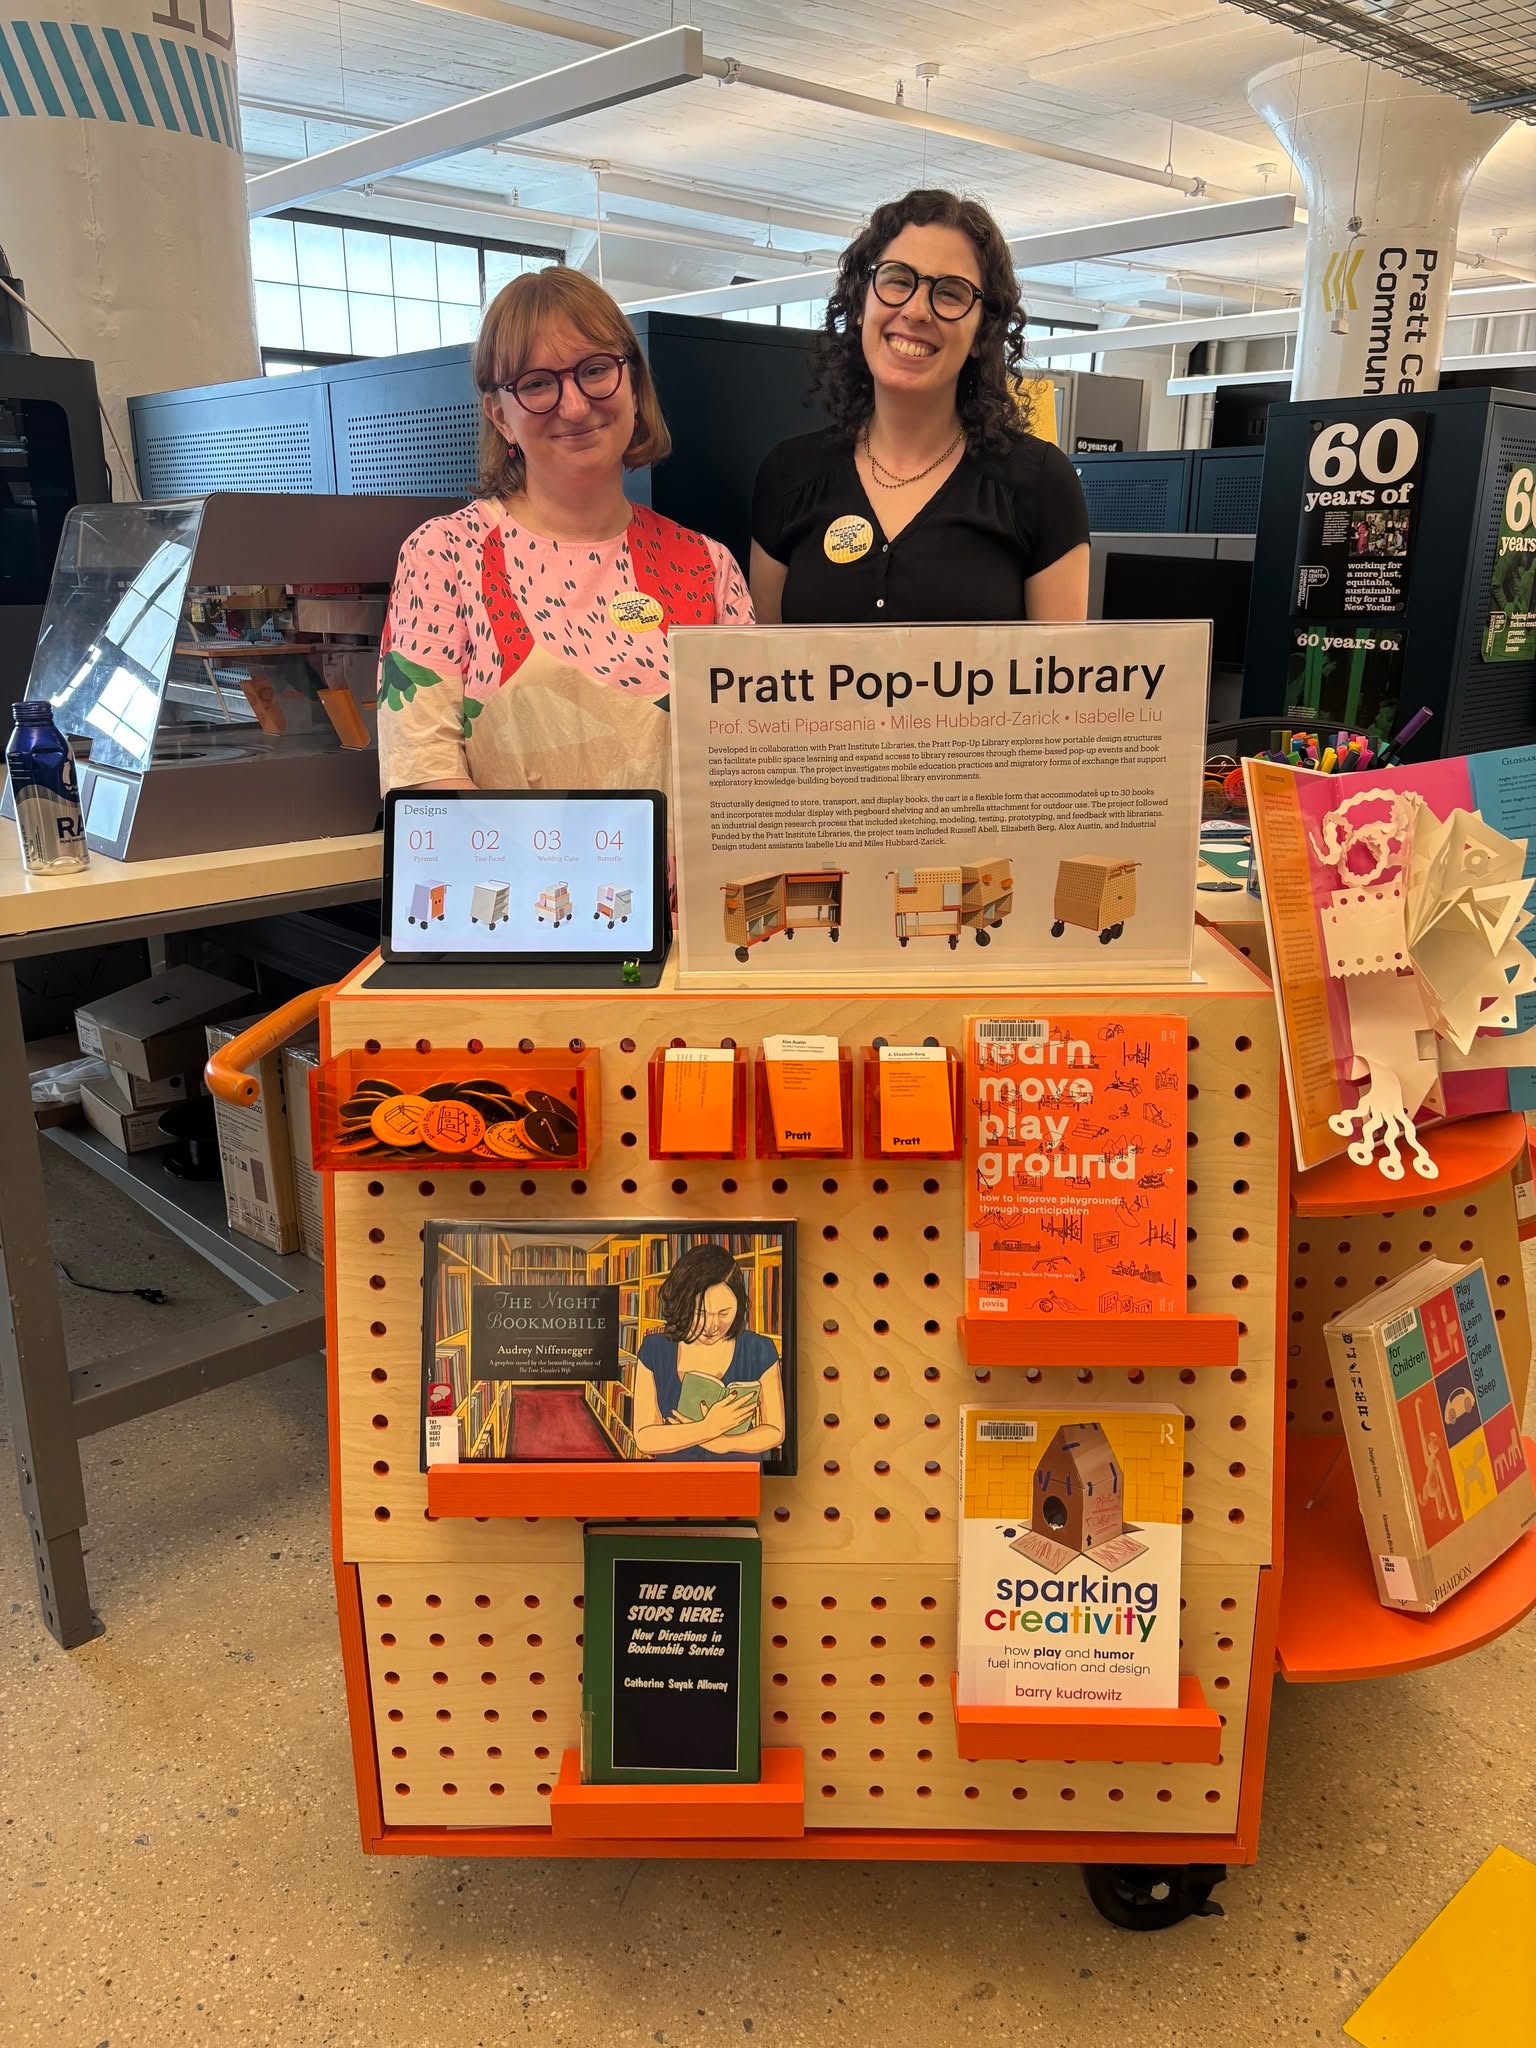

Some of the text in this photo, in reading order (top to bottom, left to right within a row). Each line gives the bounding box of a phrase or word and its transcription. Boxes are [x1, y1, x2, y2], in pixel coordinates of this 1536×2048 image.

[1404, 249, 1438, 344] Pratt
[1077, 441, 1117, 452] 60 years of
[1309, 418, 1419, 487] 60
[1304, 483, 1414, 512] years of
[1505, 468, 1536, 532] 6
[1348, 561, 1402, 570] working for
[1379, 569, 1401, 579] just,
[1345, 586, 1401, 595] sustainable
[1346, 579, 1392, 588] equitable,
[1344, 603, 1364, 611] New
[1345, 595, 1391, 605] city for all
[1297, 634, 1319, 647] 60
[1321, 634, 1375, 651] years
[709, 656, 1166, 707] Pratt Pop-Up Library
[709, 707, 1162, 735] Prof. Swati Piparsania Miles Hubbard-Zarick Isabelle Liu
[708, 746, 748, 754] Developed
[749, 744, 757, 752] in
[881, 741, 916, 749] Libraries,
[951, 739, 980, 747] Pop-Up
[1062, 736, 1094, 744] portable
[1122, 734, 1160, 742] structures
[403, 804, 447, 817] Designs
[409, 830, 624, 851] 01 02 03 04
[979, 1077, 1093, 1102] move
[785, 1131, 811, 1140] Pratt
[980, 1108, 1070, 1148] play
[893, 1137, 920, 1146] Pratt
[977, 1145, 1136, 1186] ground
[979, 1193, 999, 1203] how
[1002, 1194, 1013, 1203] to
[1016, 1194, 1057, 1206] improve
[979, 1204, 1089, 1217] through participation
[1456, 1278, 1471, 1298] Play
[493, 1290, 600, 1310] THE NIGHT
[982, 1300, 1005, 1308] jovis
[1459, 1295, 1475, 1314] Ride
[486, 1311, 607, 1330] BOOKMOBILE
[1464, 1310, 1482, 1332] Learn
[1467, 1332, 1479, 1348] Eat
[497, 1344, 593, 1357] Audrey Niffenegger
[1389, 1347, 1401, 1359] for
[1470, 1344, 1493, 1365] Create
[495, 1360, 515, 1368] graphic
[548, 1360, 575, 1368] bestselling
[1393, 1350, 1427, 1378] Children
[1474, 1366, 1484, 1382] Sit
[1477, 1379, 1497, 1399] Sleep
[1368, 1447, 1376, 1467] Design
[1374, 1474, 1382, 1497] Children
[1434, 1563, 1473, 1602] PHAIDON
[638, 1584, 717, 1601] THE BOOK
[997, 1574, 1158, 1613] sparking
[627, 1606, 724, 1623] STOPS HERE:
[984, 1606, 1156, 1642] creativity
[631, 1629, 722, 1643] New Directions in
[628, 1643, 724, 1657] Bookmobile Service
[1004, 1645, 1134, 1660] how play and humor
[988, 1657, 1150, 1676] fuel innovation and design
[624, 1677, 728, 1693] Catherine Suyak Alloway
[1015, 1685, 1122, 1701] barry kudrowitz
